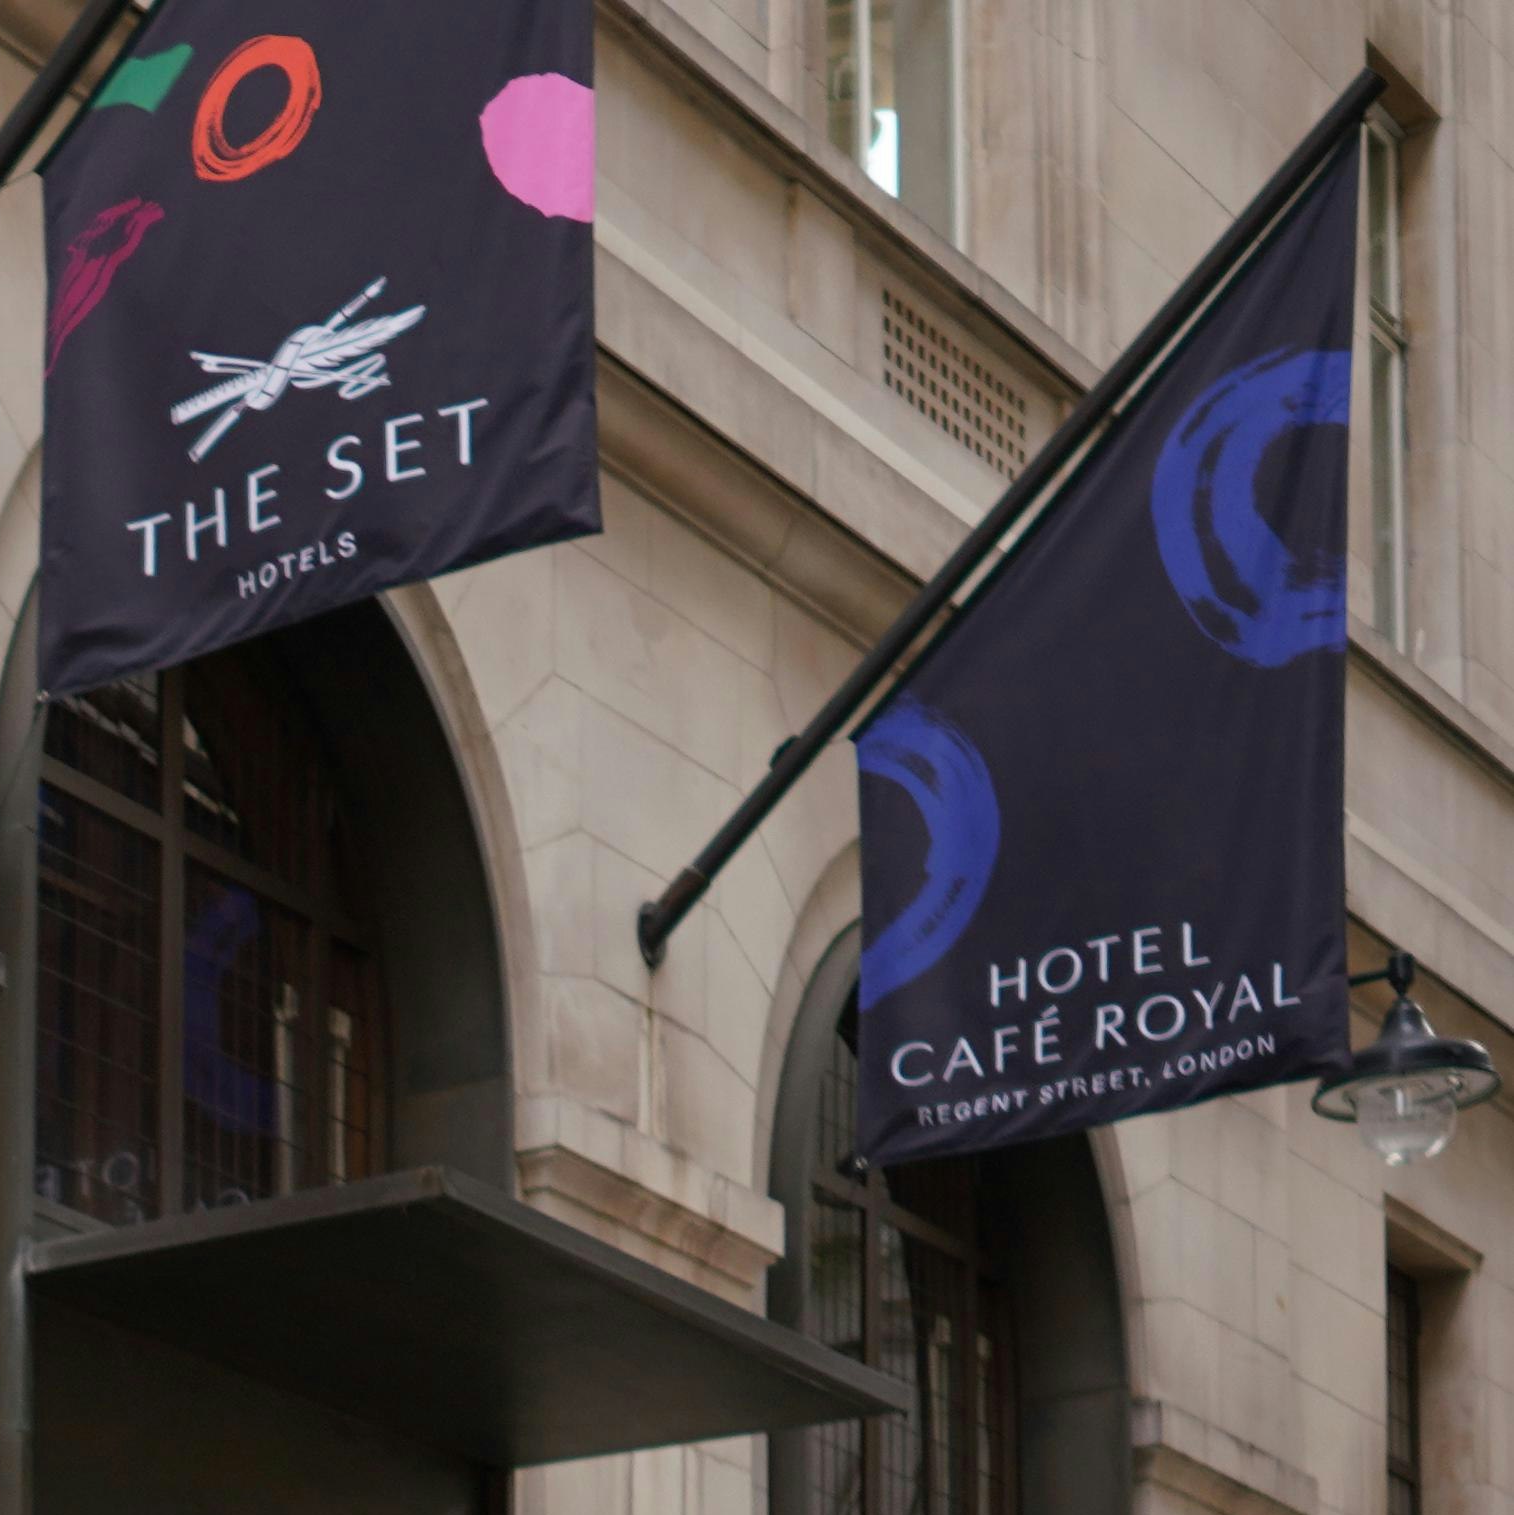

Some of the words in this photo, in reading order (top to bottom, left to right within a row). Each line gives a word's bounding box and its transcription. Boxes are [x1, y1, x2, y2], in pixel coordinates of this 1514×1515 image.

[125, 463, 282, 577] THE
[324, 397, 489, 501] SET
[236, 530, 359, 598] HOTELS
[988, 921, 1211, 1007] HOTEL
[890, 1005, 1063, 1088] CAFÉ
[1094, 962, 1302, 1051] ROYAL
[917, 1089, 1030, 1127] REGENT
[1038, 1066, 1153, 1106] STREET,
[1162, 1032, 1277, 1081] LONDON
